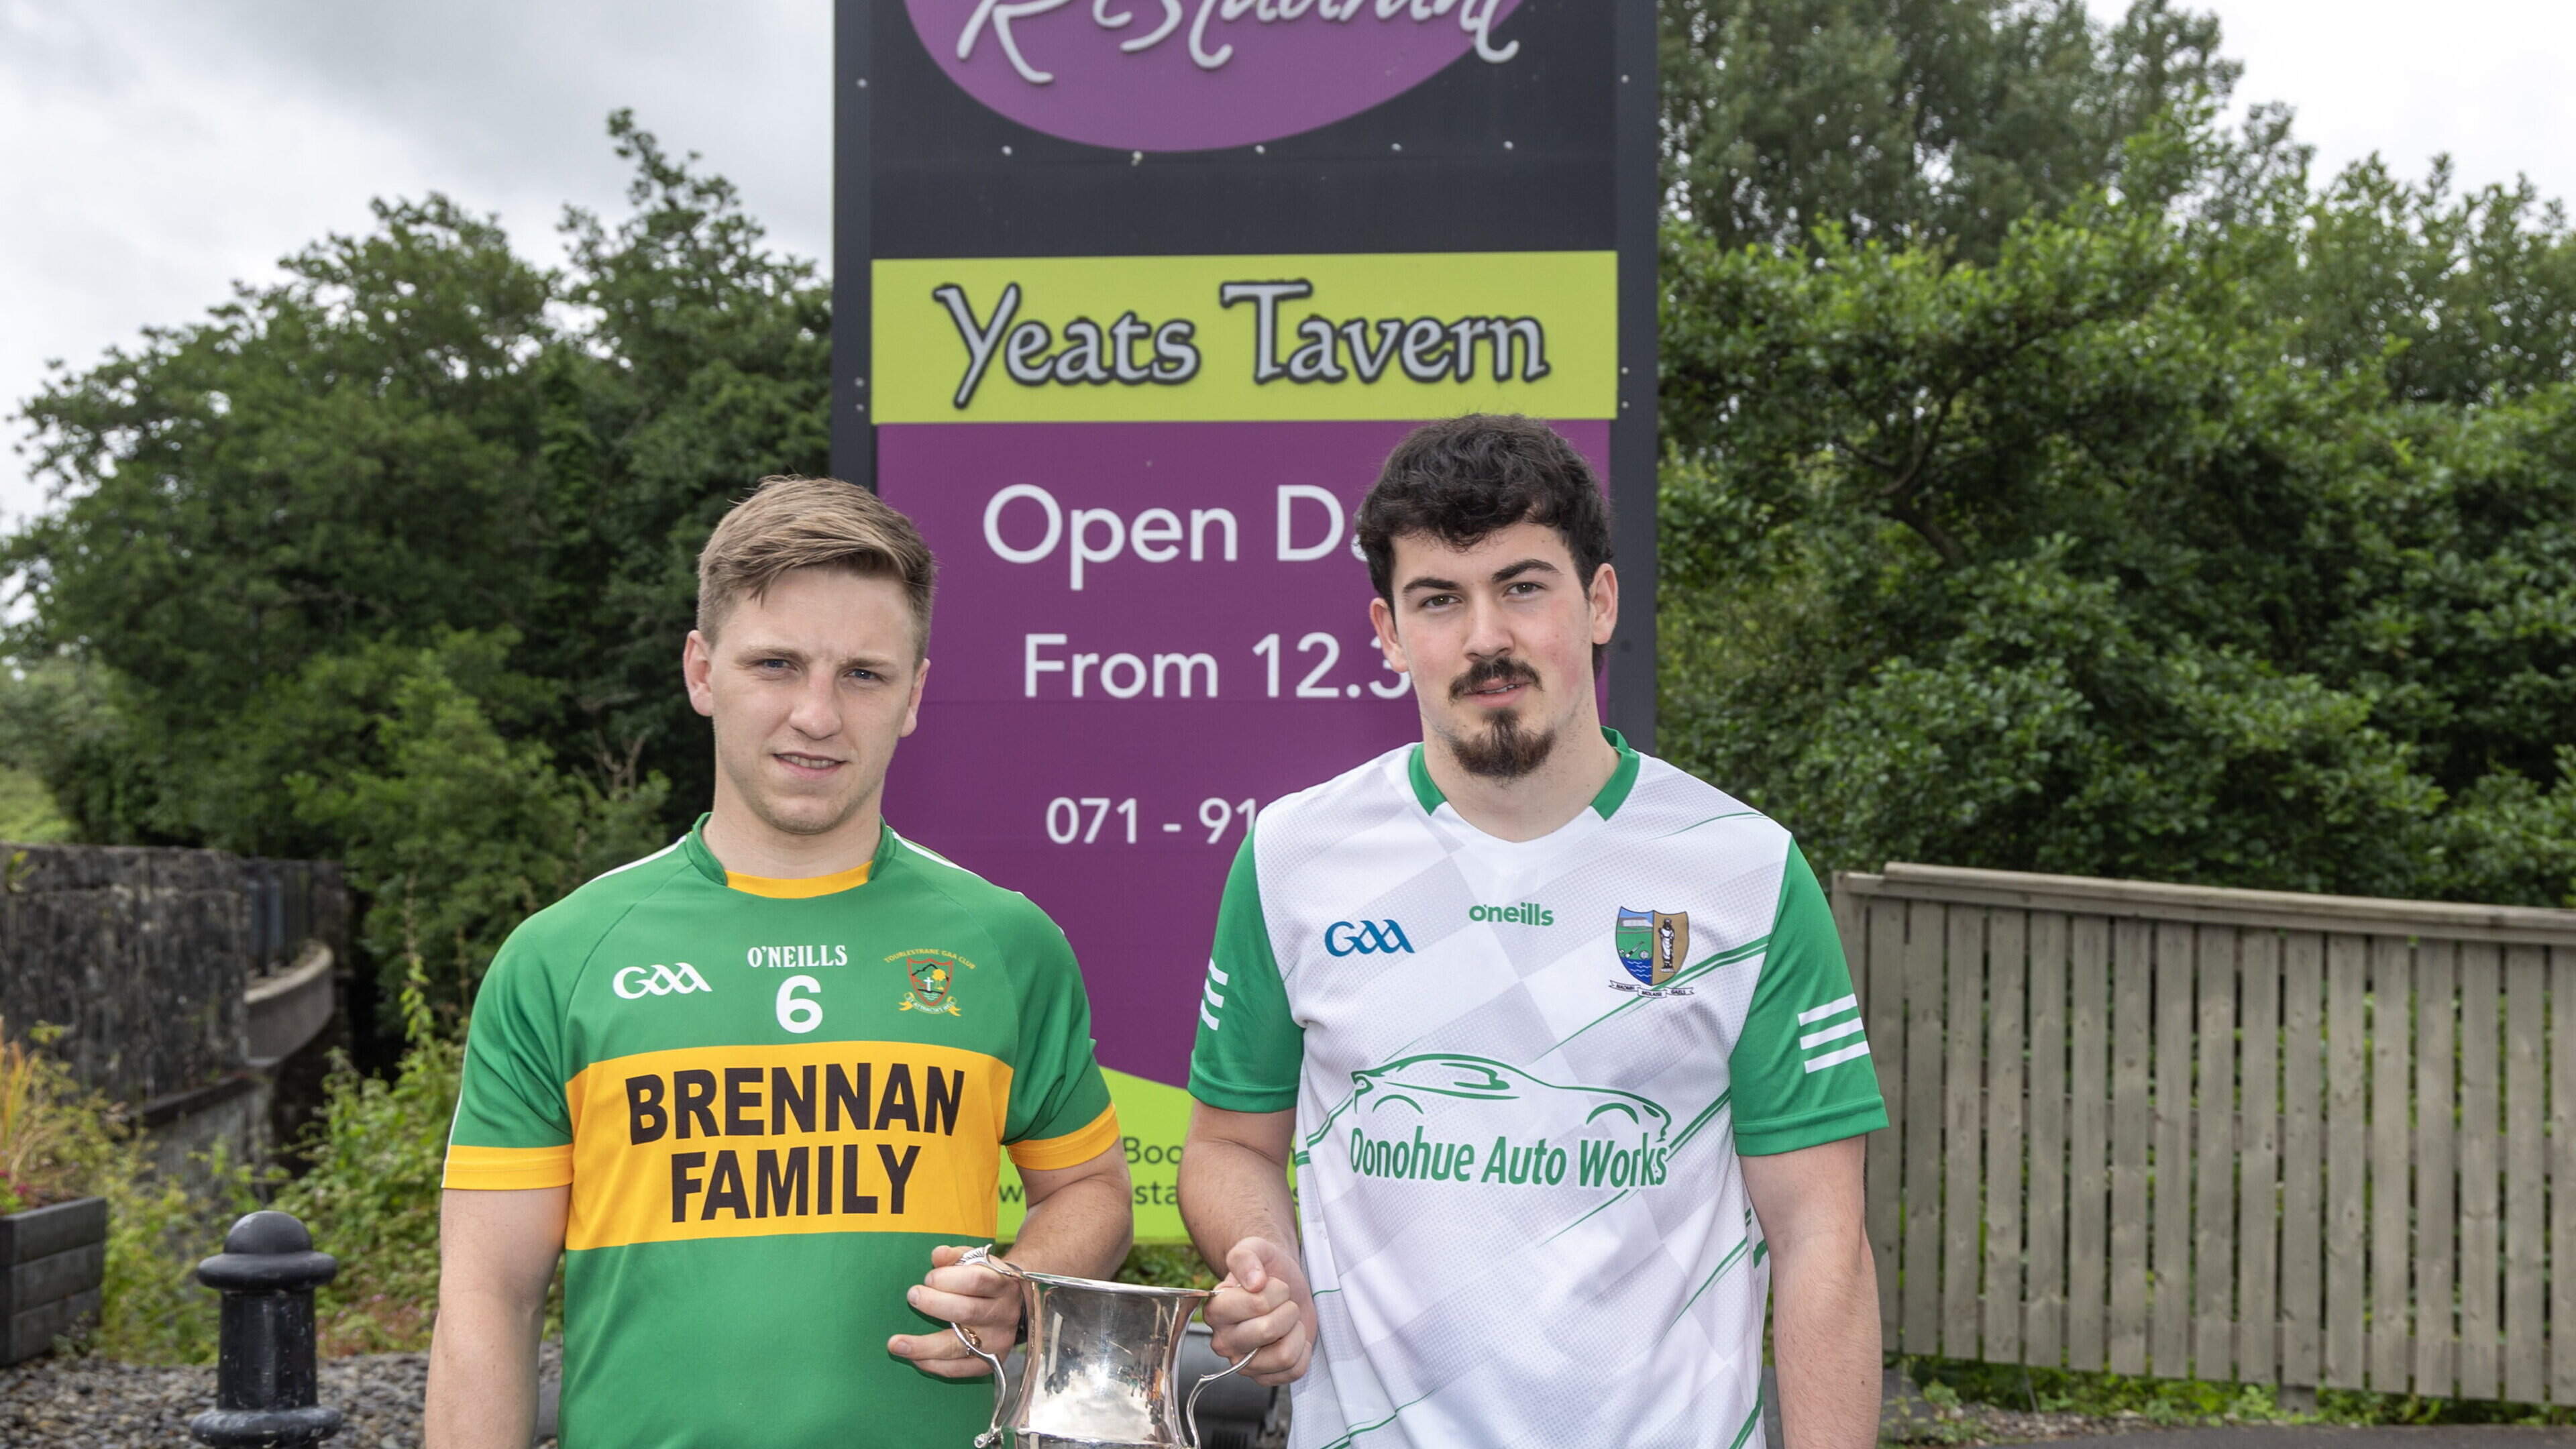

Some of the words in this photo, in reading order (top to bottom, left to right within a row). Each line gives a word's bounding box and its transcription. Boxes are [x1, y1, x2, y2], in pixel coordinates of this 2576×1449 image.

[932, 283, 1201, 410] Yeats
[1220, 280, 1550, 385] Tavern
[983, 484, 1238, 591] Open
[1277, 484, 1368, 561] D
[1025, 634, 1219, 698] From
[1252, 632, 1411, 699] 12.3
[1046, 798, 1137, 844] 071
[1199, 798, 1258, 844] 91
[1324, 919, 1415, 957] GAA
[612, 962, 713, 1000] GAA
[775, 975, 823, 1034] 6
[625, 1063, 965, 1146] BRENNAN
[1122, 1136, 1183, 1165] Boo
[1350, 1125, 1476, 1182] Donohue
[1481, 1135, 1568, 1186] Auto
[1579, 1132, 1668, 1188] Works
[671, 1144, 922, 1223] FAMILY
